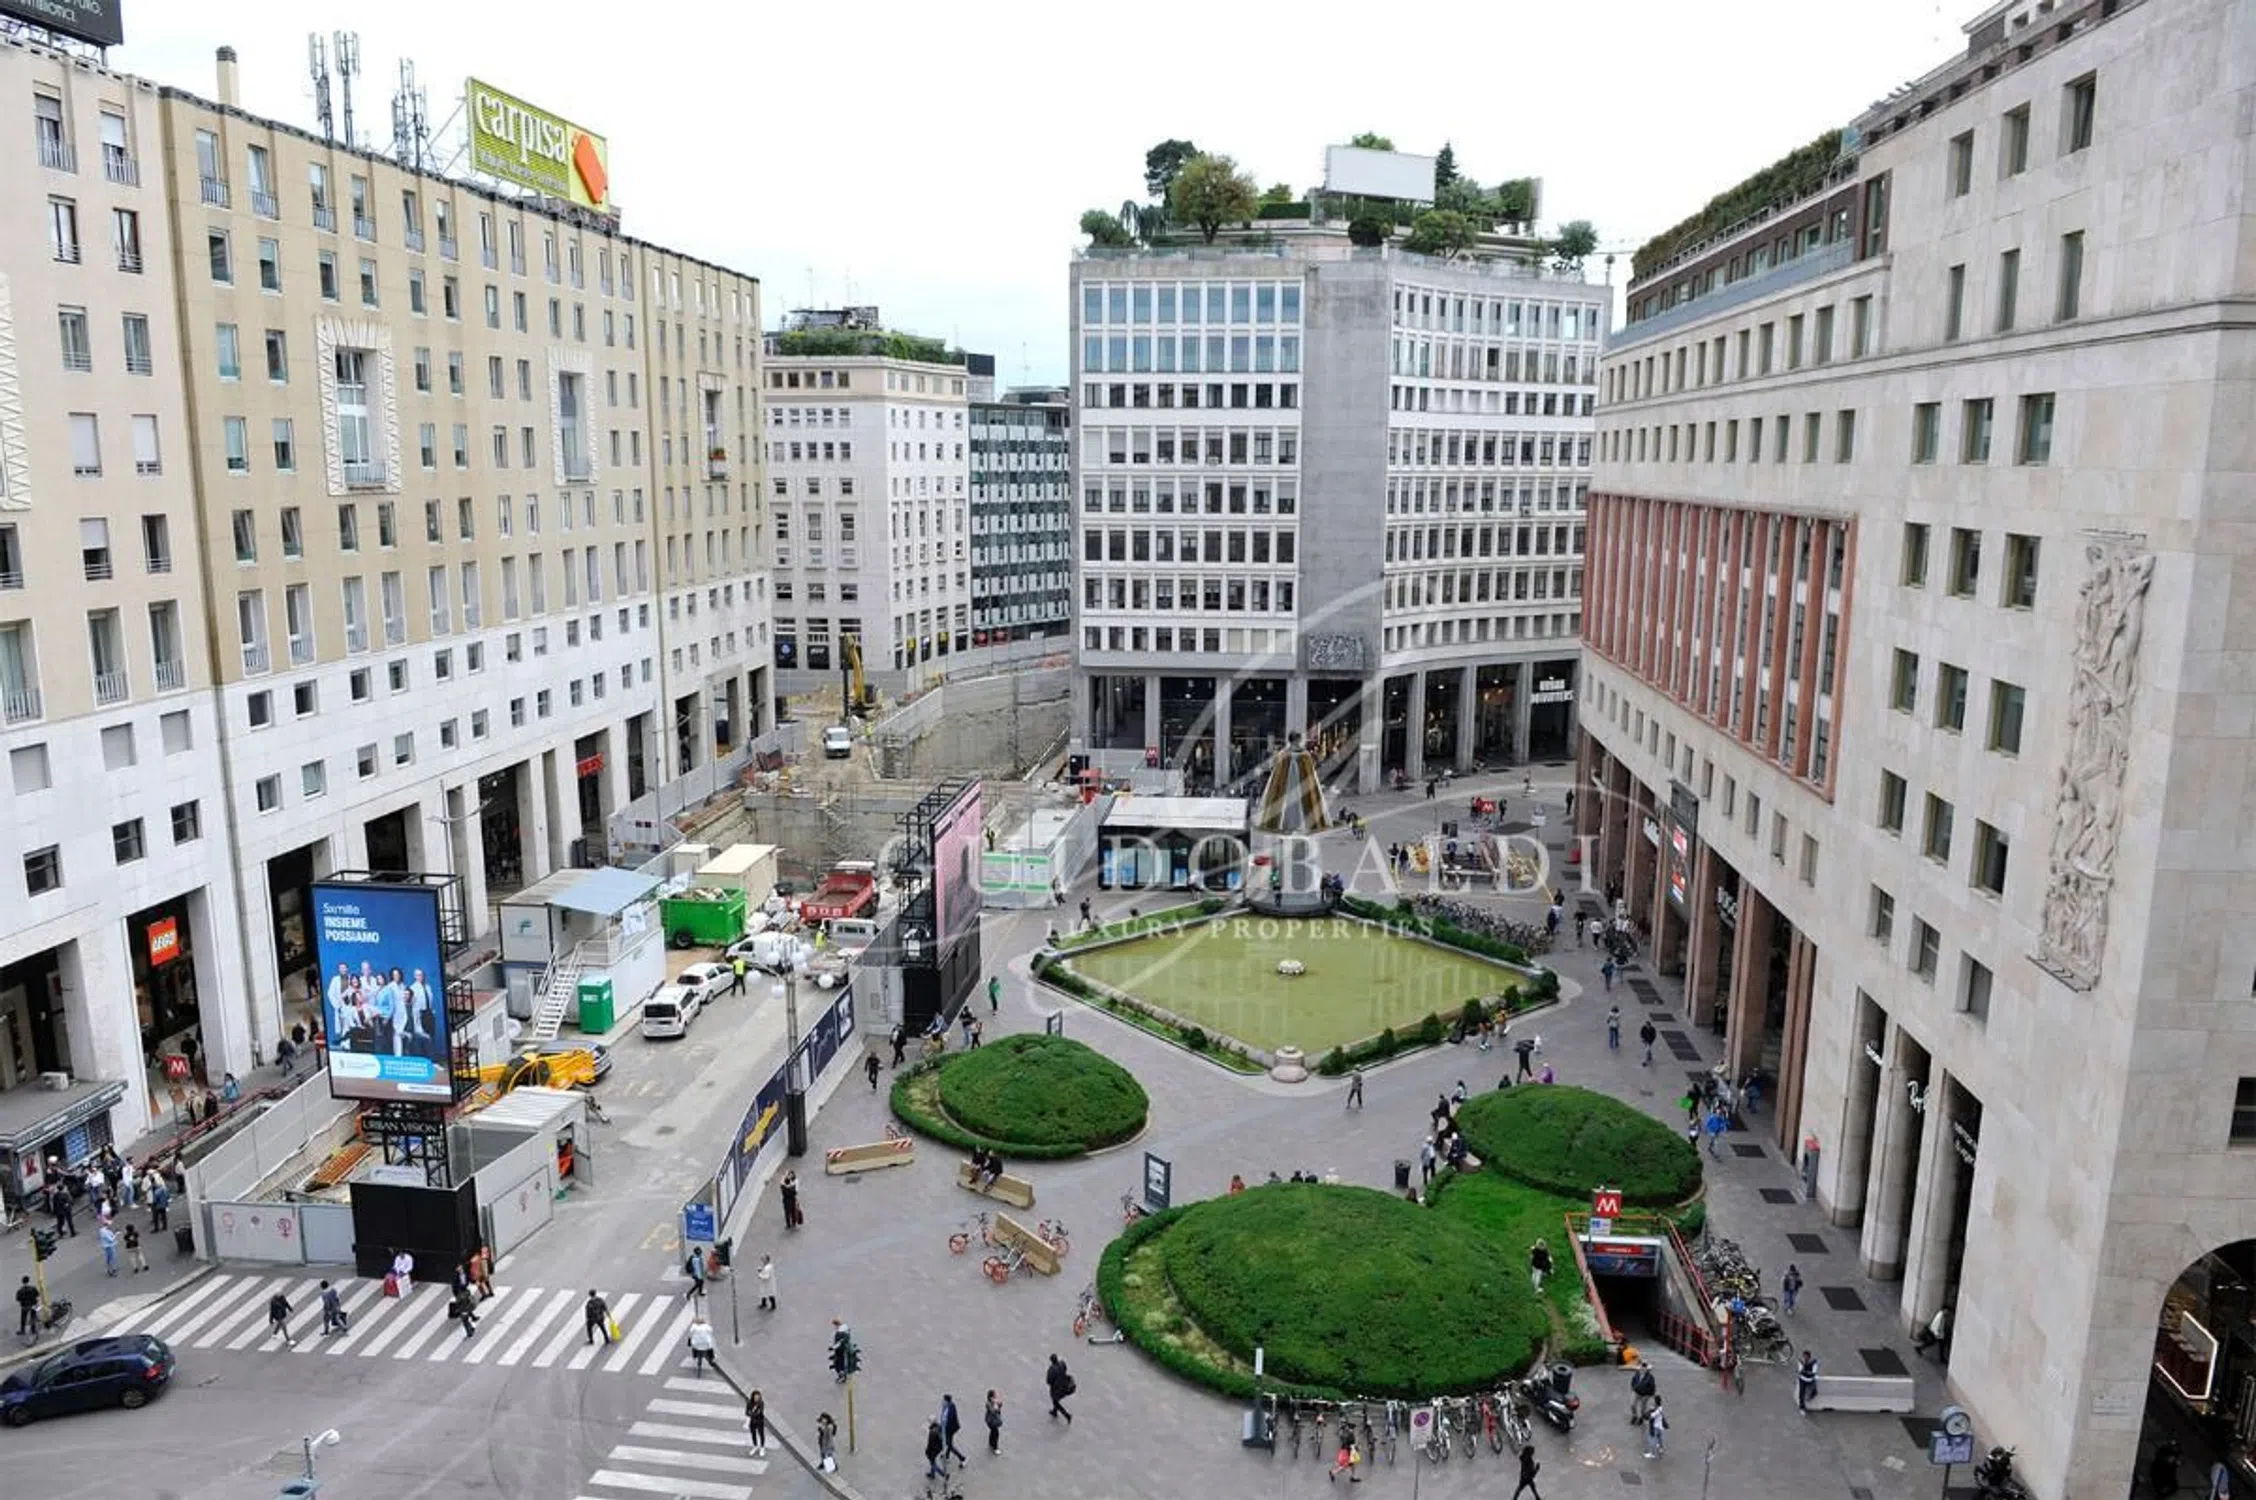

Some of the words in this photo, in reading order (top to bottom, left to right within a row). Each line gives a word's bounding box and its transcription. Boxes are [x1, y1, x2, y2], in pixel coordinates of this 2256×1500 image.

[476, 91, 567, 165] carpisa
[323, 916, 369, 929] INSIEME
[153, 931, 176, 951] LEGO
[325, 930, 380, 943] POSSIAMO
[170, 1061, 187, 1074] M
[363, 1119, 399, 1132] URBAN
[400, 1121, 437, 1134] VISION
[1597, 1197, 1618, 1213] M
